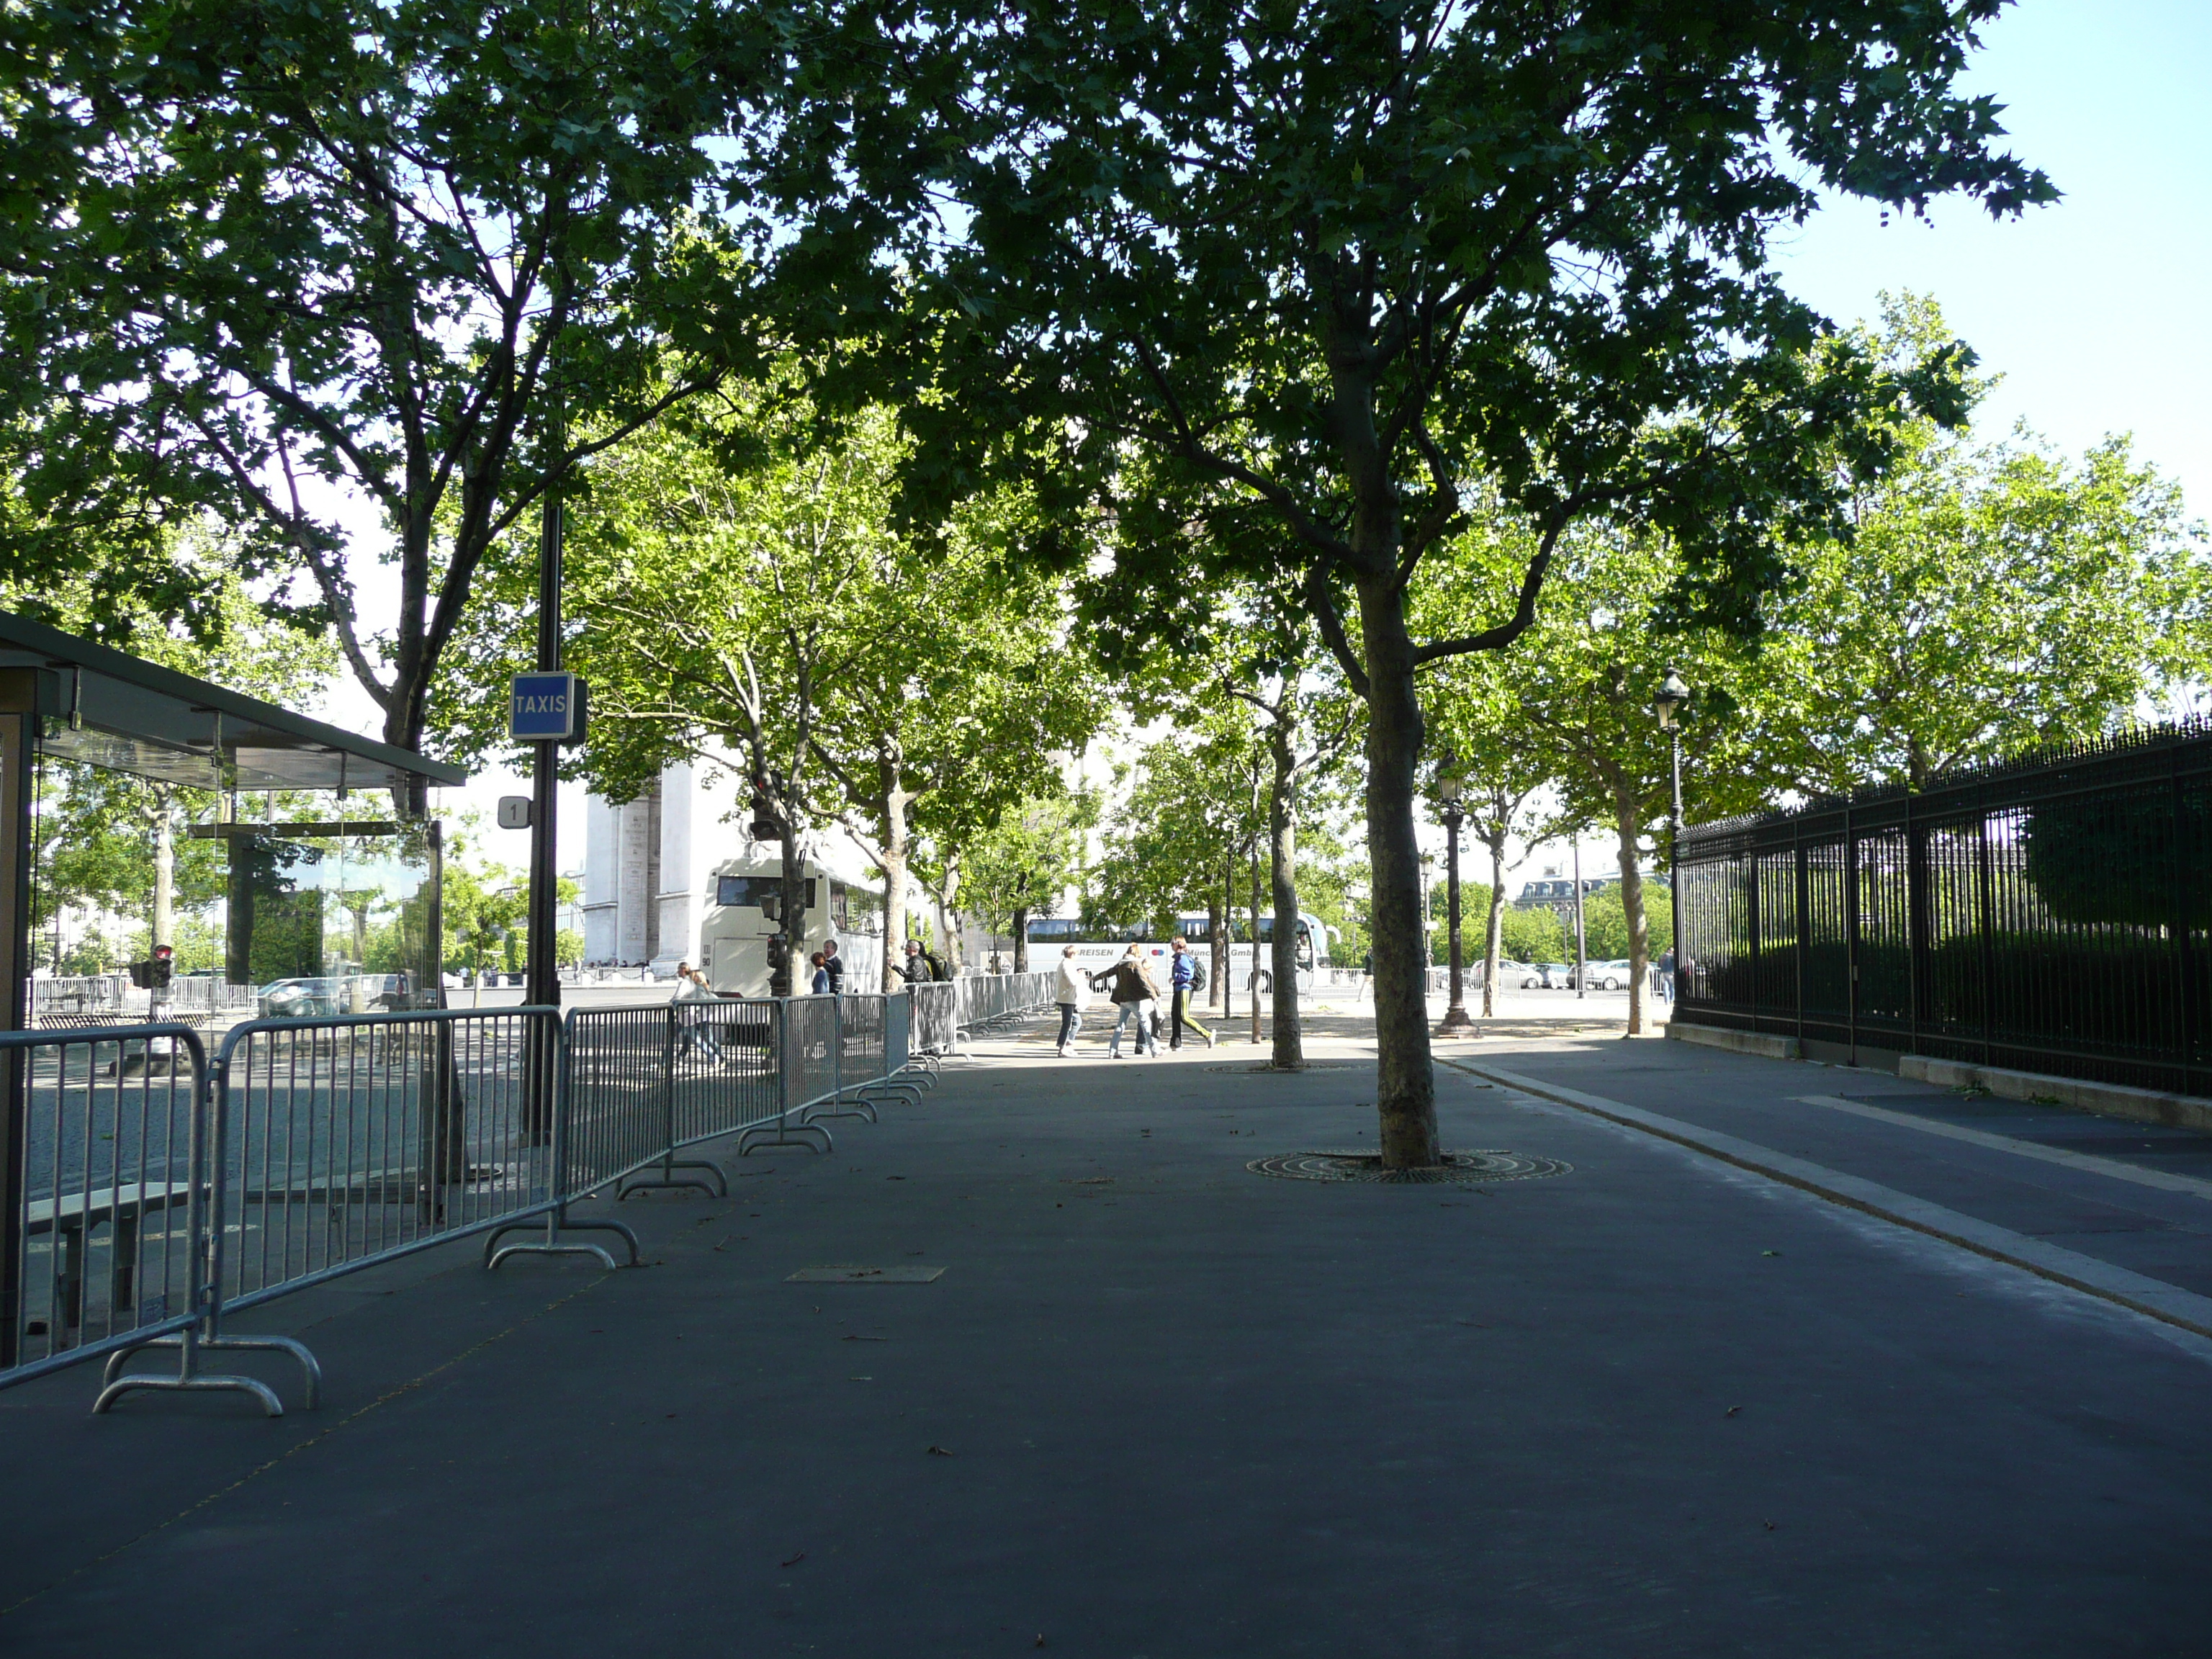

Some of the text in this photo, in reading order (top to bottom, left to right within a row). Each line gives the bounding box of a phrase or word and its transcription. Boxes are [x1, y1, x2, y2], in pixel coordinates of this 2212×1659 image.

[516, 696, 566, 714] TAXIS
[511, 804, 516, 821] 1
[1061, 948, 1252, 957] REISEN Münc Gmb
[702, 957, 711, 966] 90
